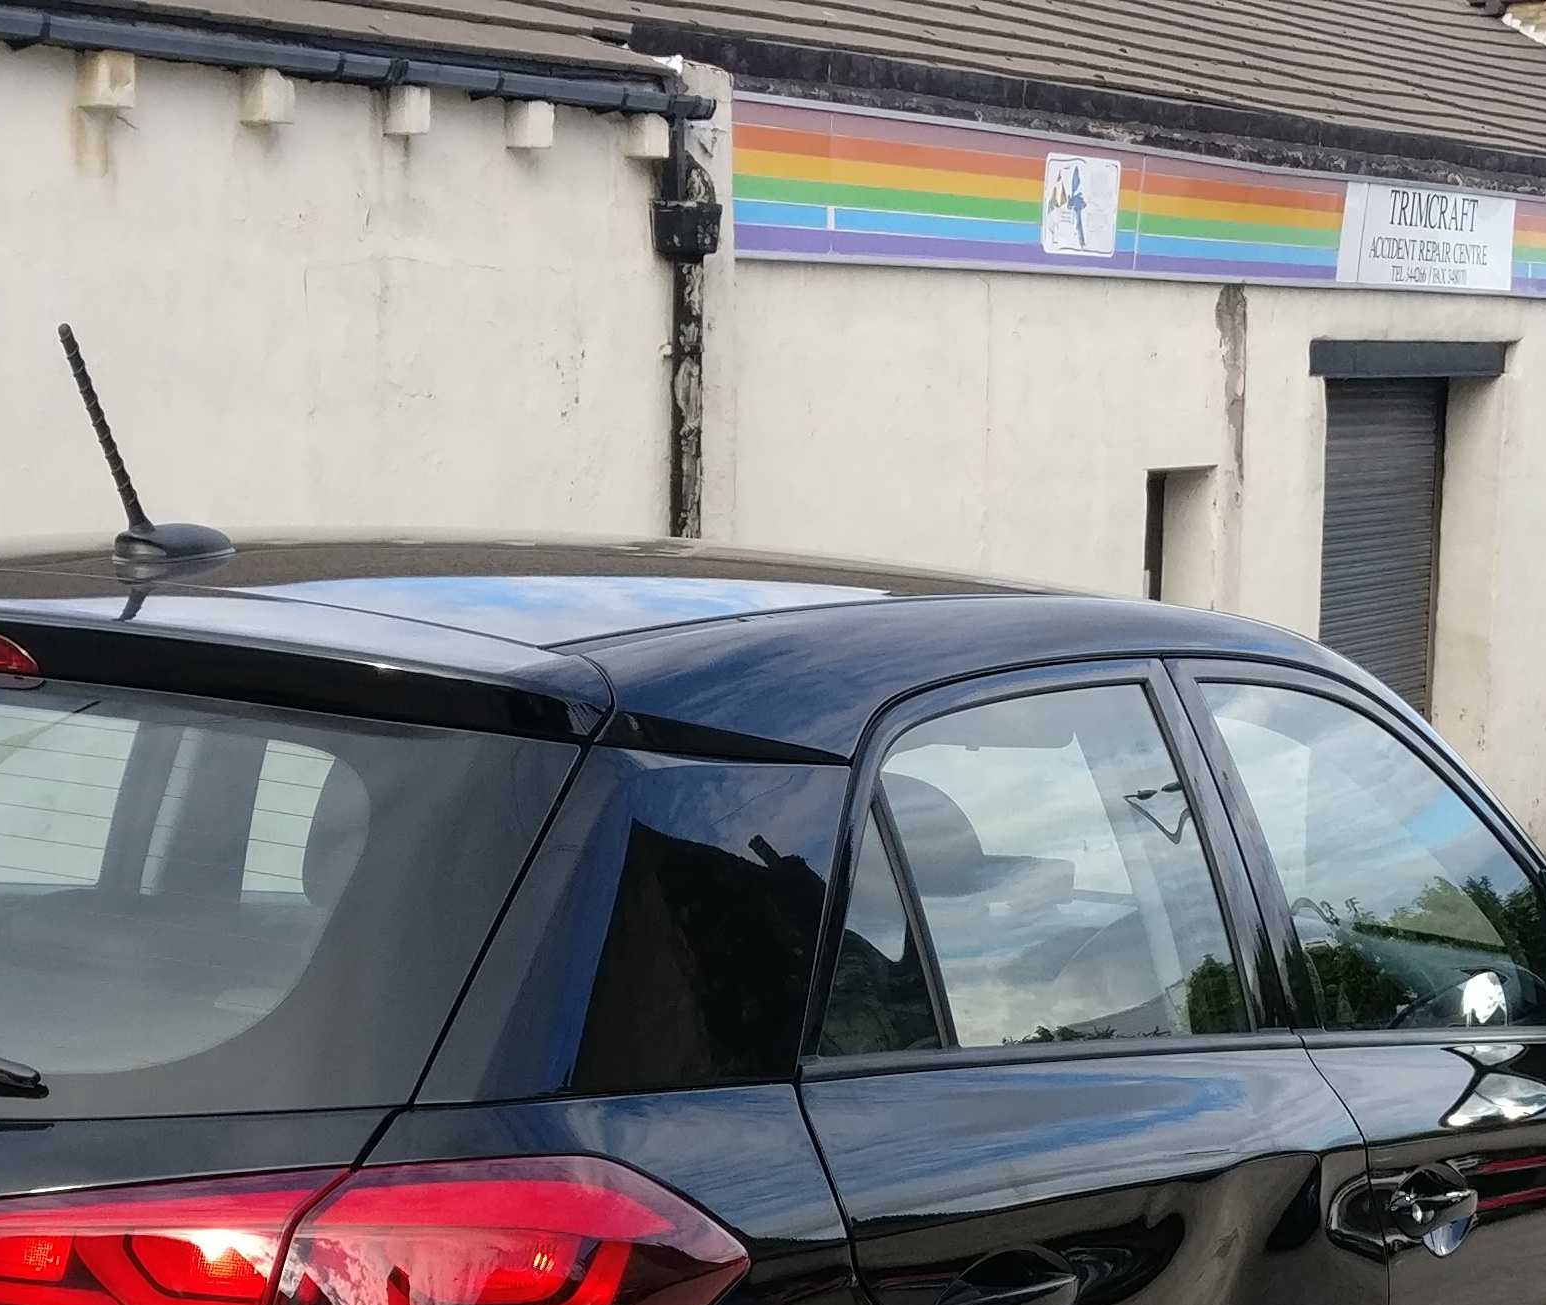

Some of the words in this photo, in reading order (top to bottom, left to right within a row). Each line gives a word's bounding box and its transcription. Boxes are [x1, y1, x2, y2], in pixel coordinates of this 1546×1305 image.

[1389, 189, 1479, 233] TRIMCRAFT
[1368, 235, 1418, 261] ACCIDENT
[1418, 240, 1452, 263] REPAIR
[1453, 242, 1488, 266] CENTRE
